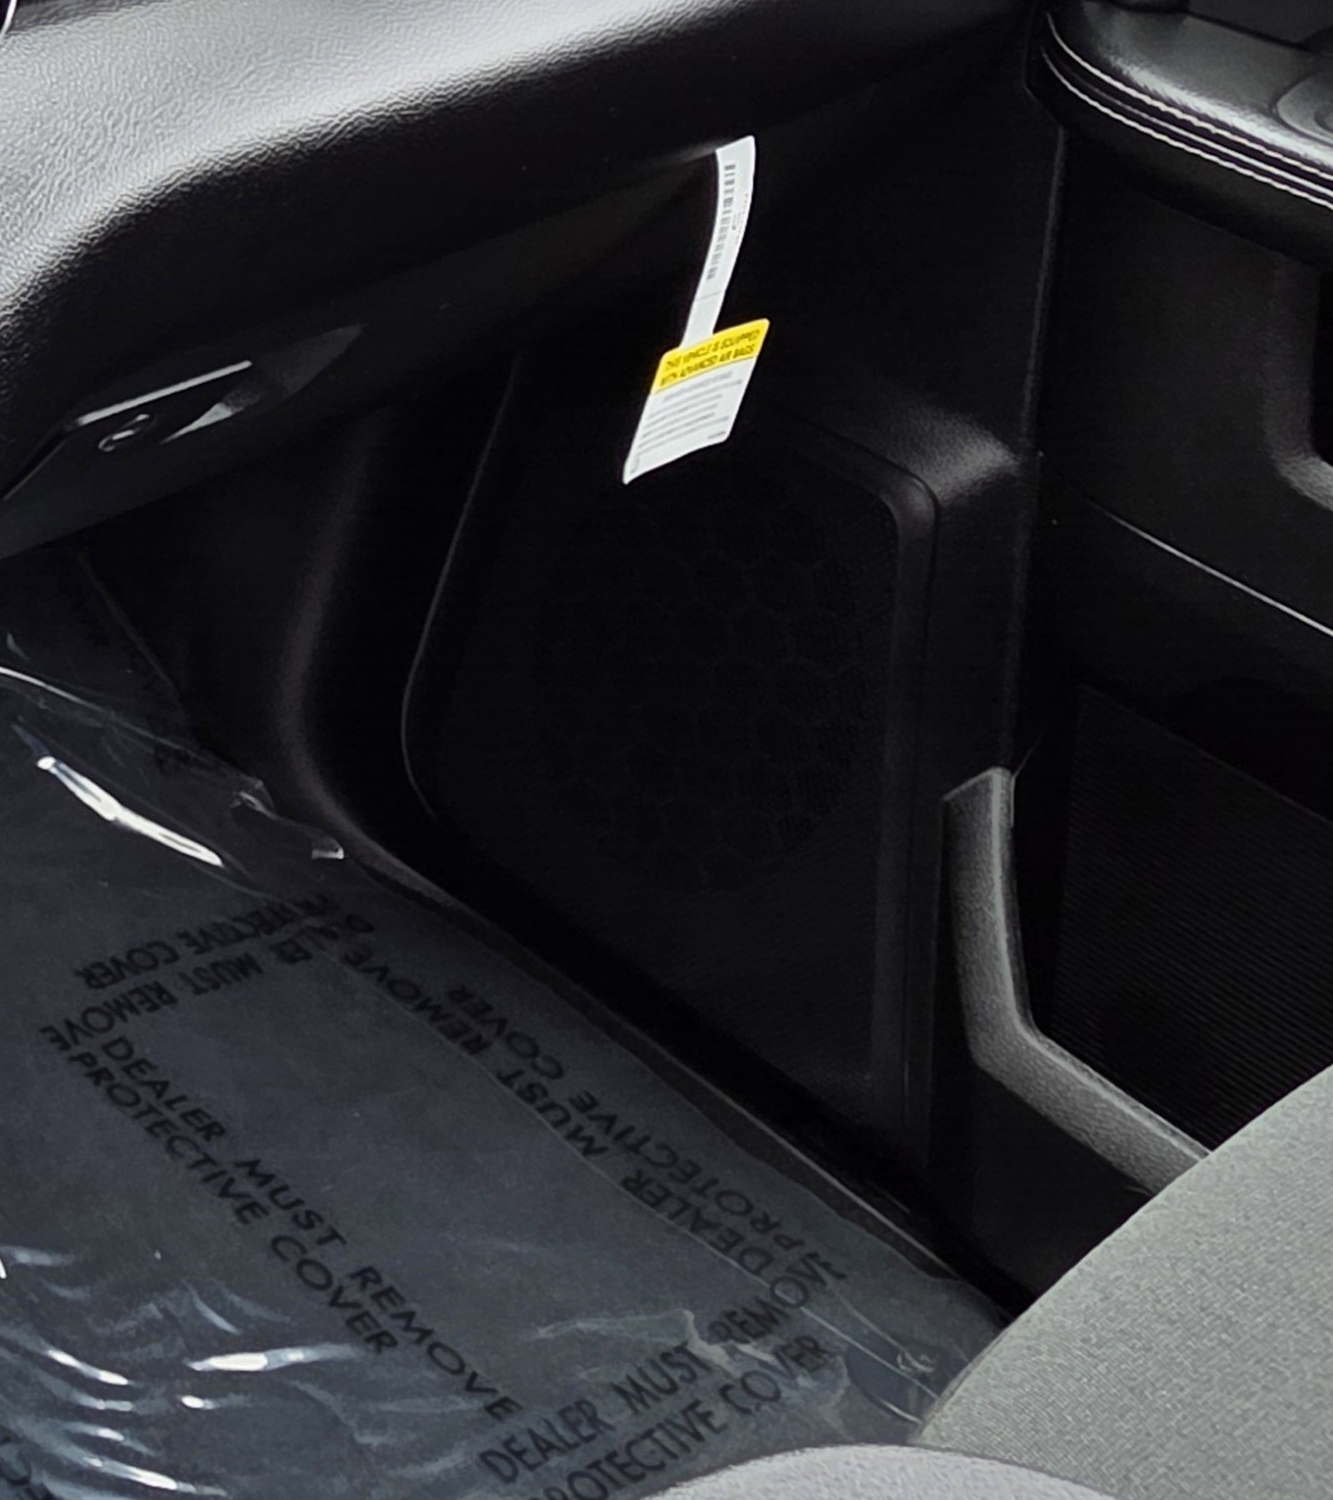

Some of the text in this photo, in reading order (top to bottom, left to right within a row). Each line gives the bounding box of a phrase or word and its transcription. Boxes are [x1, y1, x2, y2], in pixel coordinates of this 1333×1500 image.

[39, 980, 177, 1053] REMOVE
[74, 940, 179, 991] COVER
[177, 952, 264, 997] MUST
[67, 1051, 400, 1355] PROTECTIVE COVER
[100, 1034, 523, 1423] DEALER MUST REMOVE
[341, 948, 776, 1278] DEALER MUST REMOVE
[448, 984, 809, 1259] PROTECTIVE COVER
[478, 1250, 848, 1485] DEALER MUST REMOVE
[531, 1398, 730, 1500] ROTECTIVE
